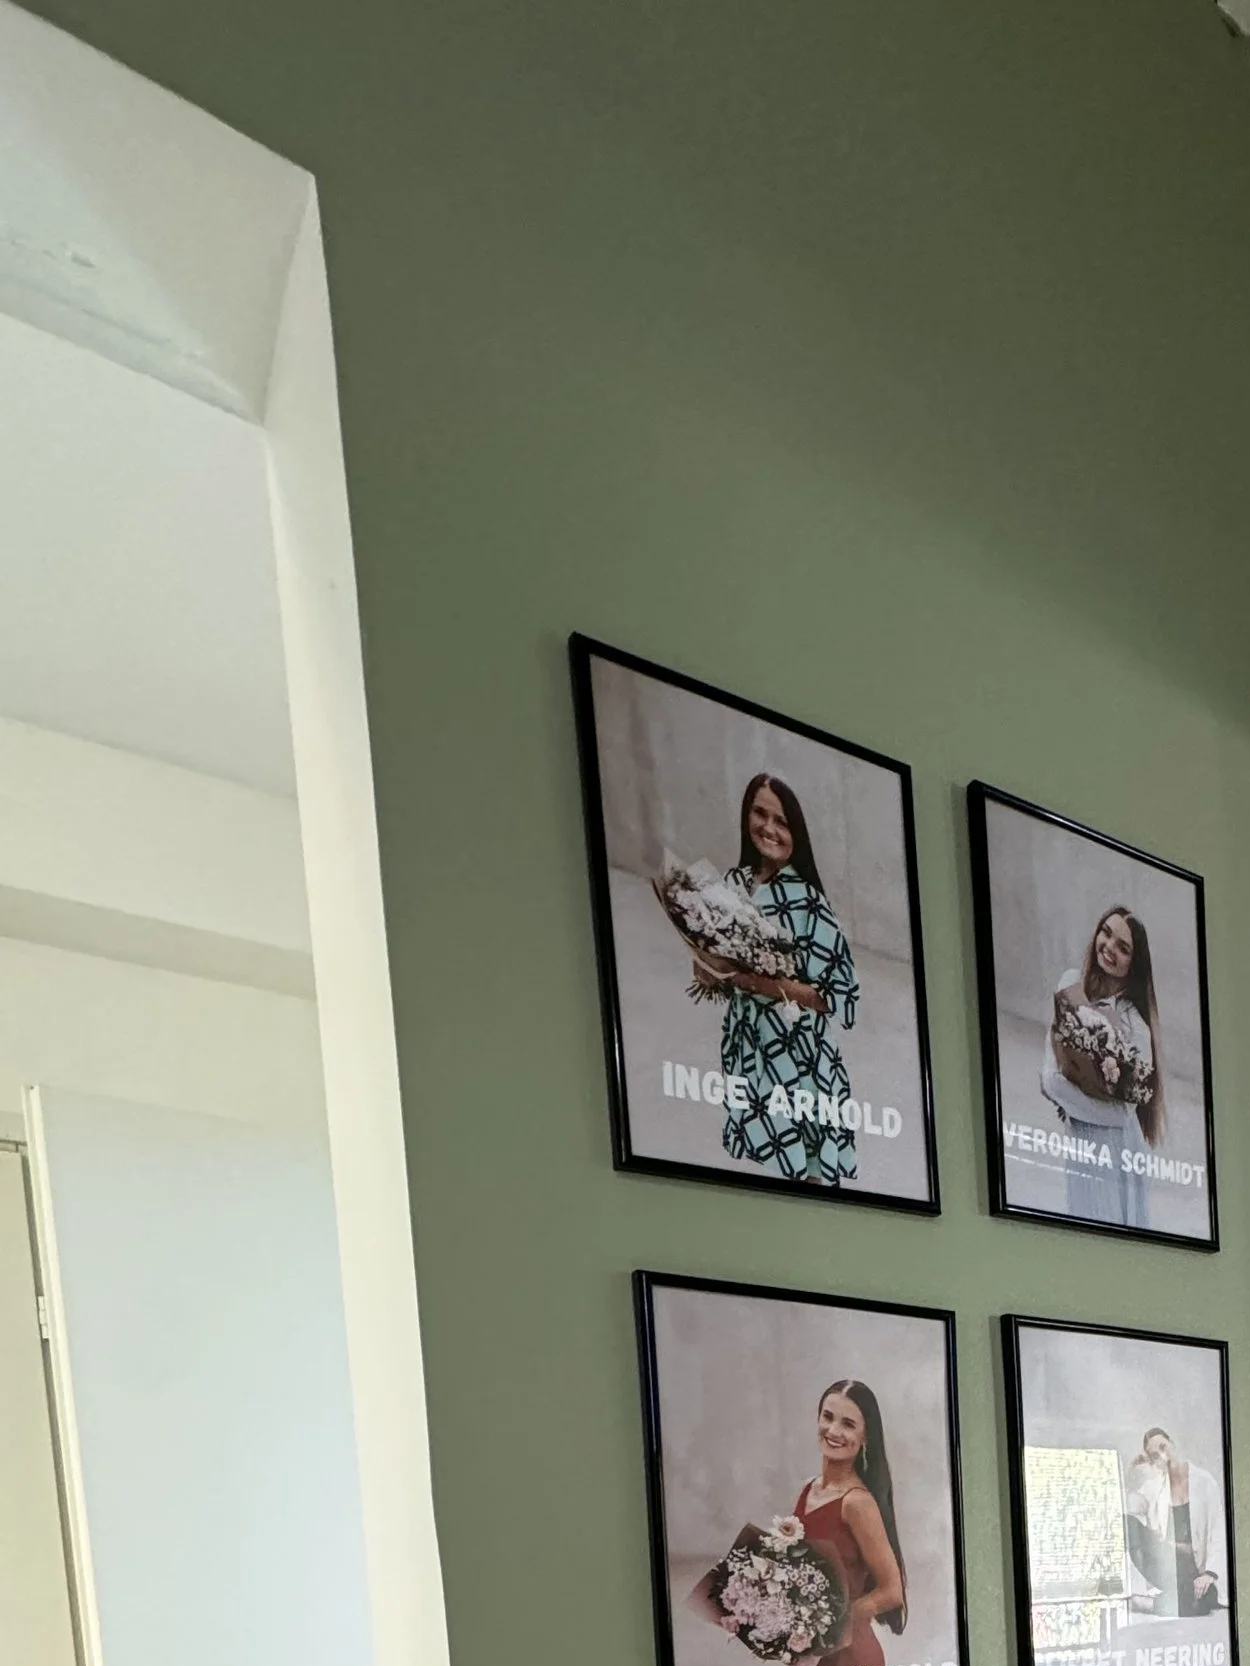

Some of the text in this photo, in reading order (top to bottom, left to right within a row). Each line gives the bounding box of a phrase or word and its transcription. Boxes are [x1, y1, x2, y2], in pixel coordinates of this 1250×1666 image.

[662, 1061, 903, 1139] INGE ARNOLD
[1003, 1120, 1205, 1188] VERONIKA SCHMIDT
